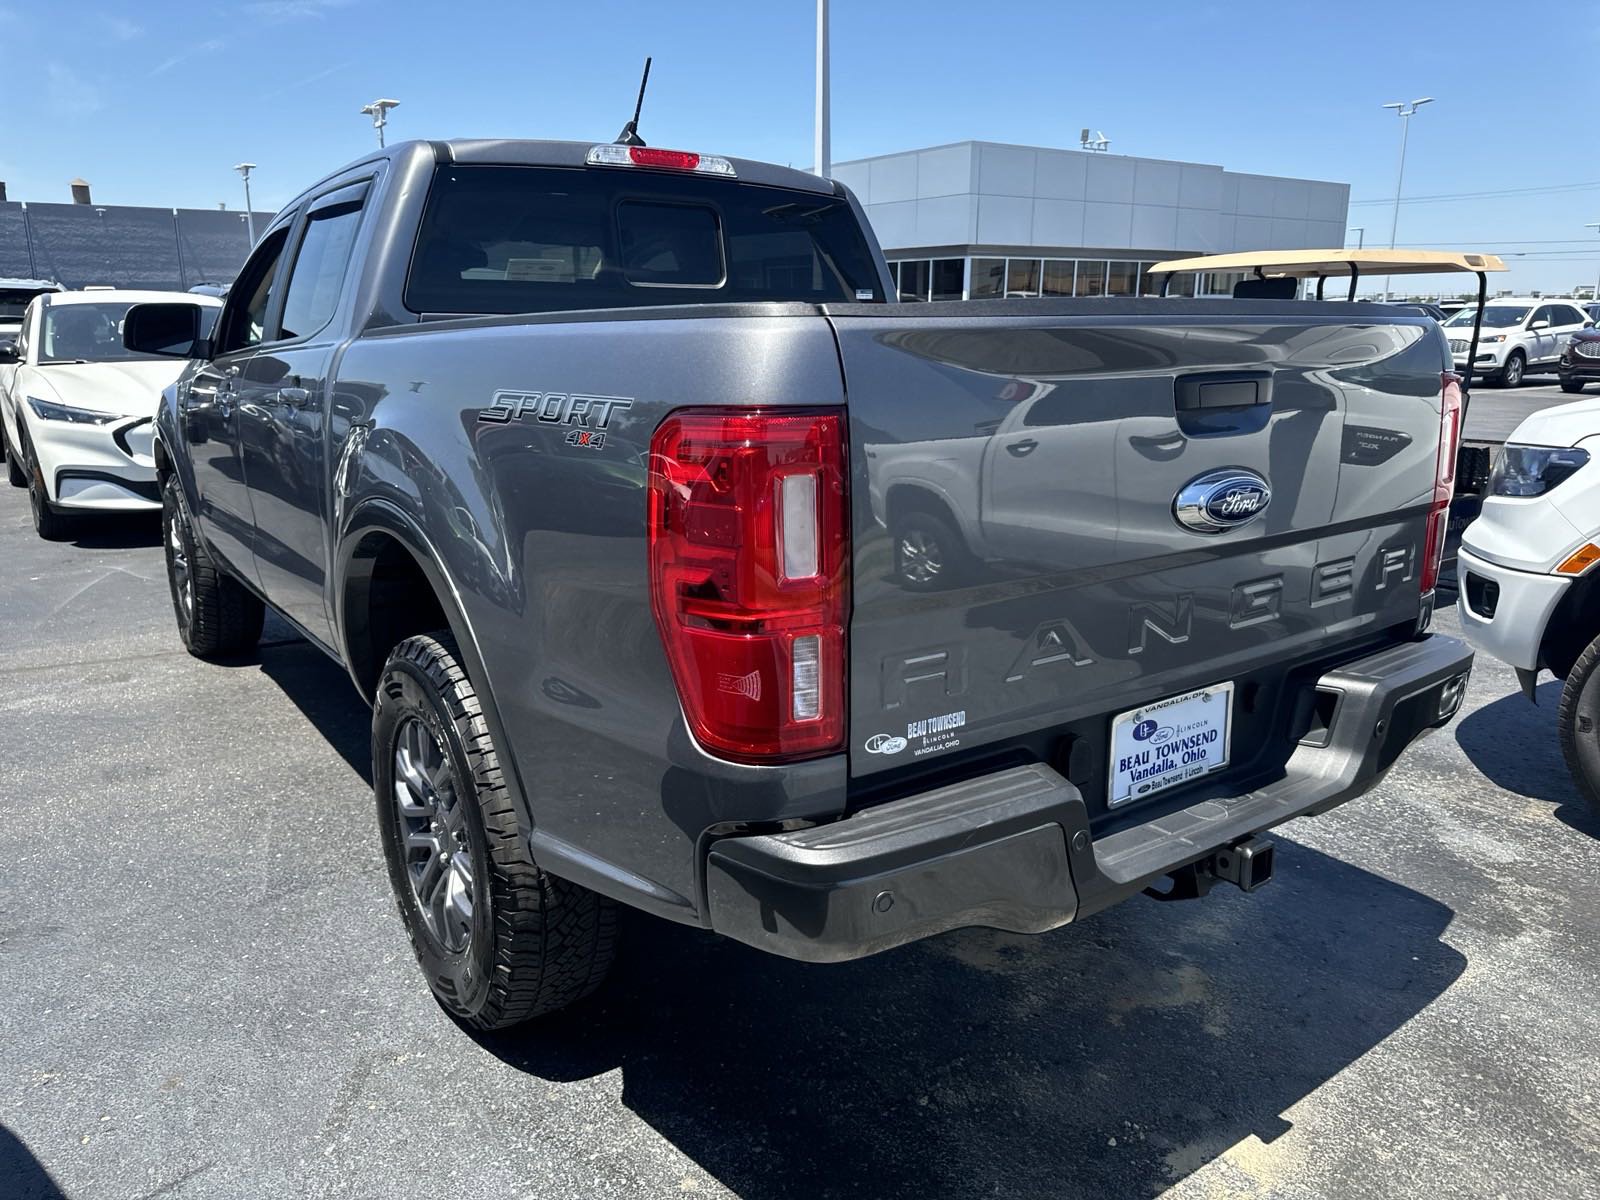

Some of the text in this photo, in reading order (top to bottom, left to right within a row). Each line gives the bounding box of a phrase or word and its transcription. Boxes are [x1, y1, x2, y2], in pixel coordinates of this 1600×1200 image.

[477, 388, 635, 431] SPORT
[1221, 487, 1259, 514] Ford
[881, 546, 1415, 710] RANGER
[907, 711, 965, 739] BEAU TOWNSEND
[926, 732, 954, 744] LINCOLN
[1180, 720, 1208, 733] LINCOLN
[945, 739, 960, 749] OHIO
[1120, 750, 1150, 773] BEAU
[1155, 729, 1218, 760] TOWNSEND
[1130, 748, 1207, 782] Vandalia, Ohio
[1151, 779, 1163, 791] Beau
[1162, 772, 1183, 786] Townsend
[1188, 765, 1204, 777] Lincoln
